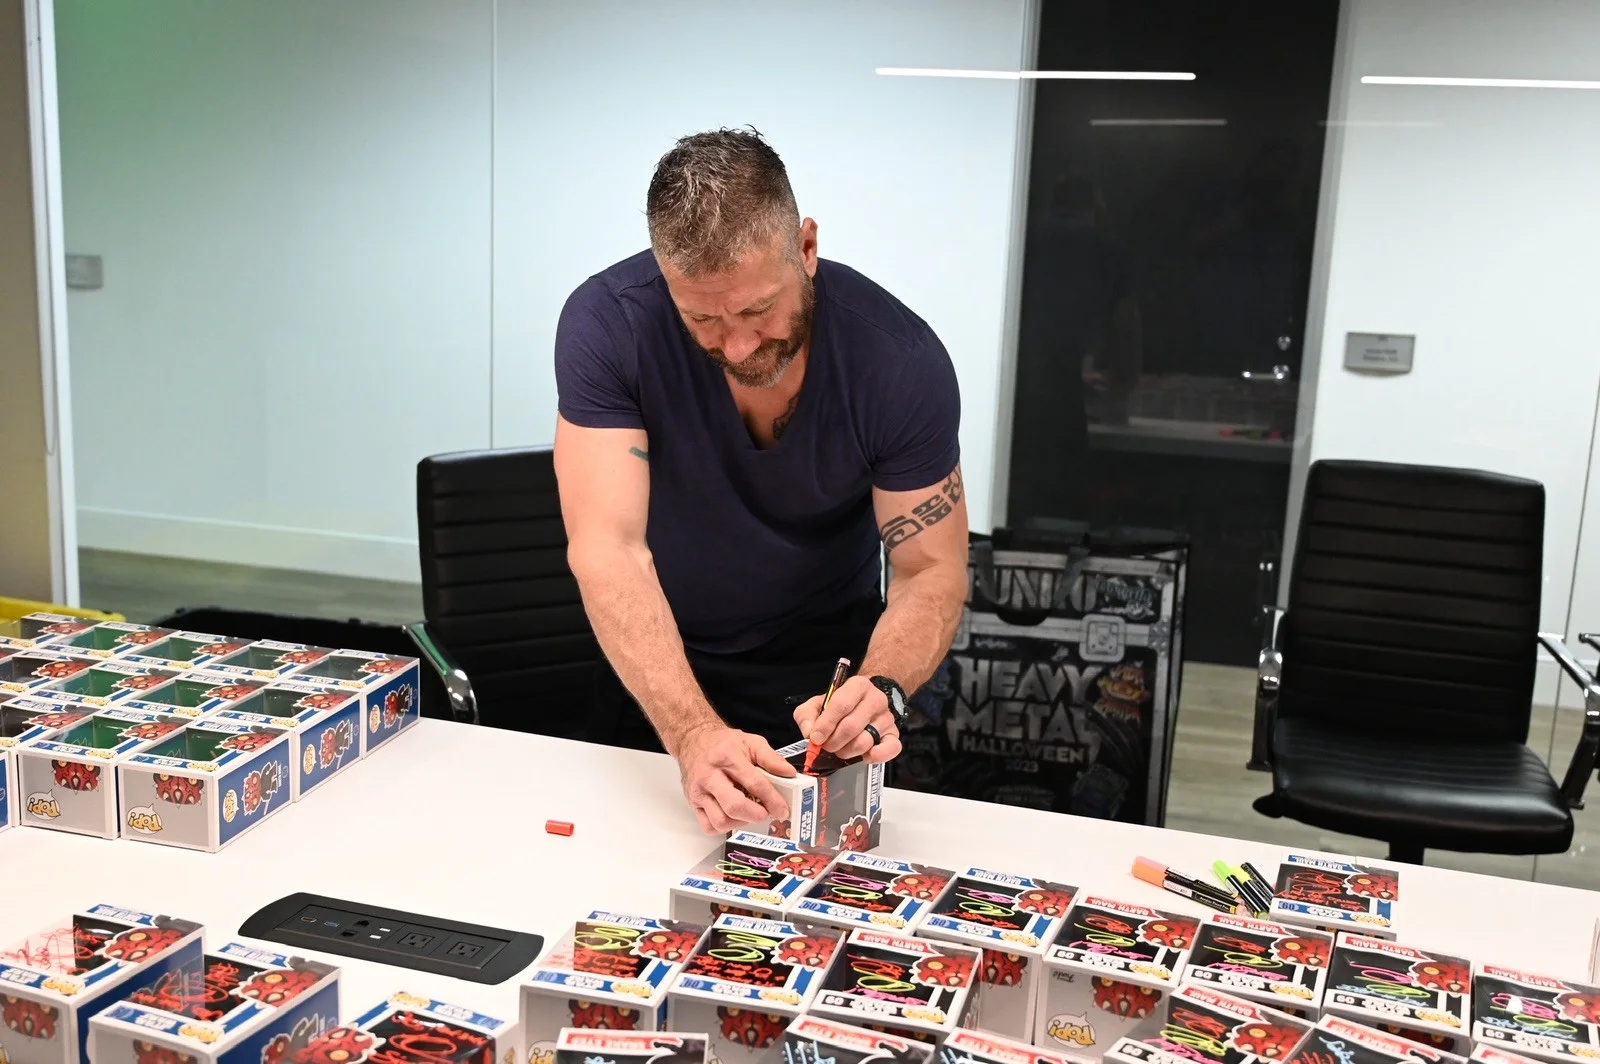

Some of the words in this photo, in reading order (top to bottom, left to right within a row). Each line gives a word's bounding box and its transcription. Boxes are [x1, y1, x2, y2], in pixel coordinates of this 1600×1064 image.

[968, 565, 1096, 612] UNO
[953, 656, 1106, 706] HEAVY
[961, 735, 1090, 764] HALLOWEEN
[27, 797, 61, 818] POP!
[128, 812, 163, 831] POP!
[1091, 899, 1117, 910] MAUL
[1117, 903, 1149, 917] DARTH
[1219, 917, 1245, 928] MAUL
[1246, 922, 1280, 935] DARTH
[863, 935, 891, 946] MAUL
[890, 938, 925, 952] DARTH
[1352, 939, 1379, 950] MAUL
[1381, 944, 1415, 957] DARTH
[1490, 968, 1519, 981] MAUL
[1520, 975, 1556, 989] DARTH
[1189, 991, 1218, 1006] MAUL
[1217, 999, 1253, 1017] DARTH
[1047, 1020, 1096, 1047] POP!
